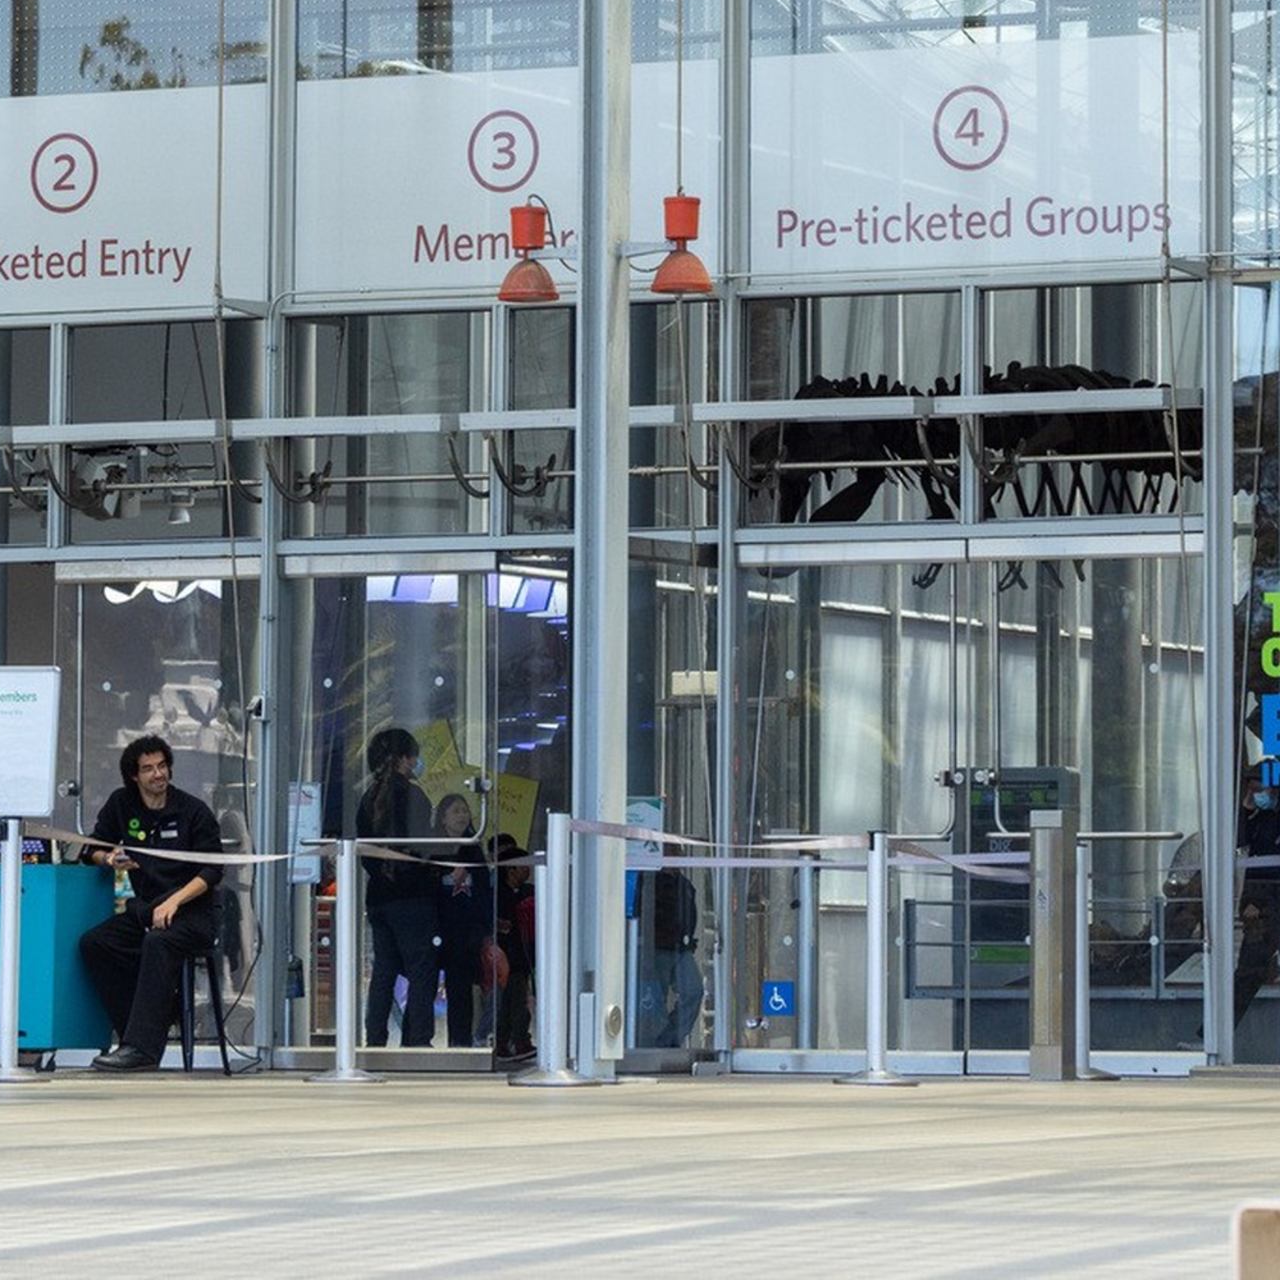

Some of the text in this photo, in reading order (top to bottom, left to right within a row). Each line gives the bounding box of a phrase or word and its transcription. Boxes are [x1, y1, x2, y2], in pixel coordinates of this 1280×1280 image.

[954, 106, 985, 147] 4
[492, 131, 517, 172] 3
[53, 153, 77, 192] 2
[776, 195, 1173, 249] Pre-ticketed Groups
[98, 237, 192, 283] Entry
